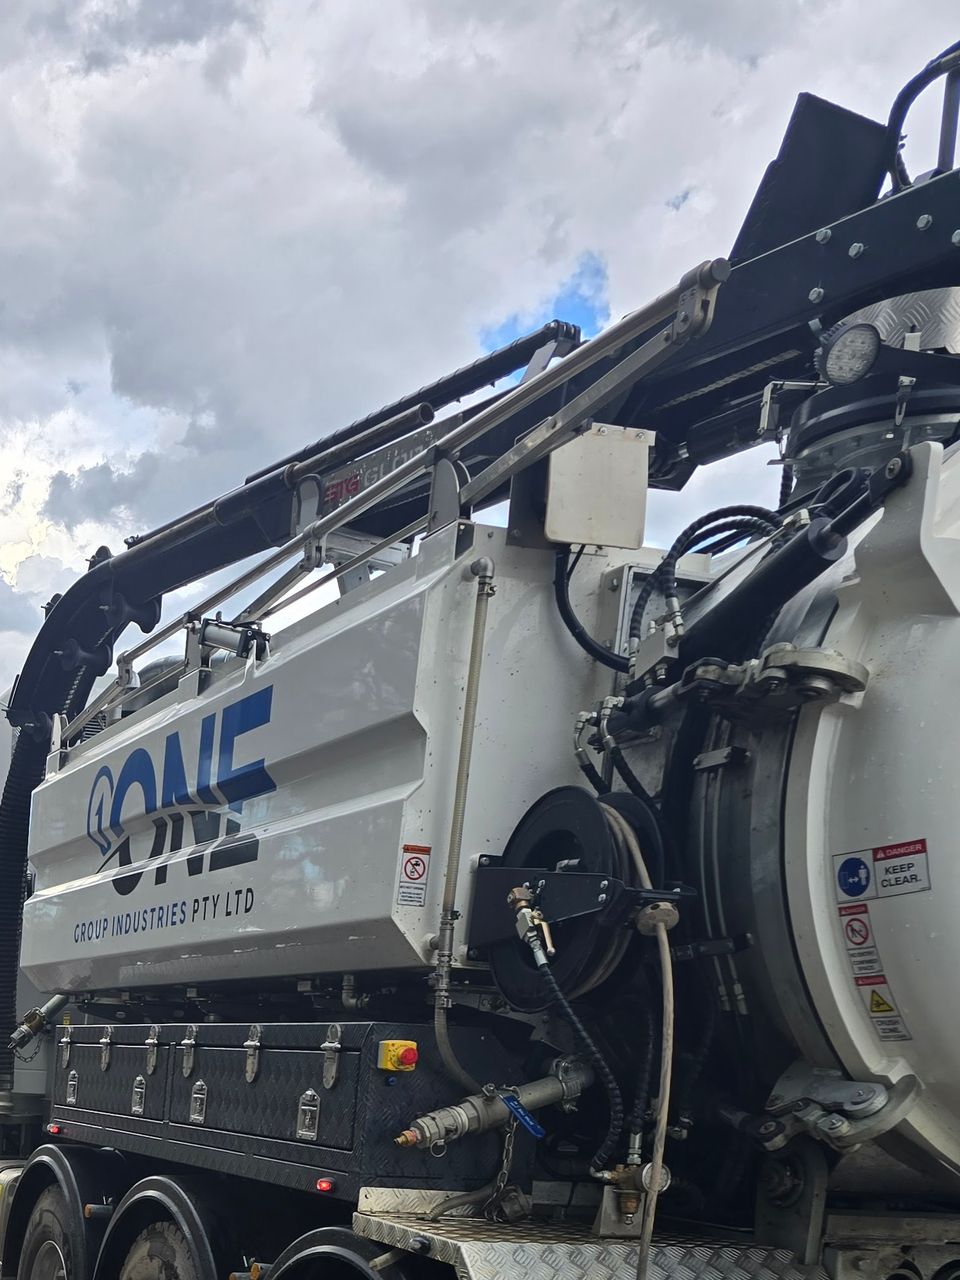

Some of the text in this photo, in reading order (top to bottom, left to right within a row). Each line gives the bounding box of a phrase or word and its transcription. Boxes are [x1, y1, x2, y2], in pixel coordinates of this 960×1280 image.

[108, 684, 277, 896] ONE
[885, 843, 922, 856] DANGER
[884, 862, 915, 875] KEEP
[881, 874, 922, 888] CLEAR.
[73, 887, 255, 944] GROUP INDUSTRIES PTY LTD
